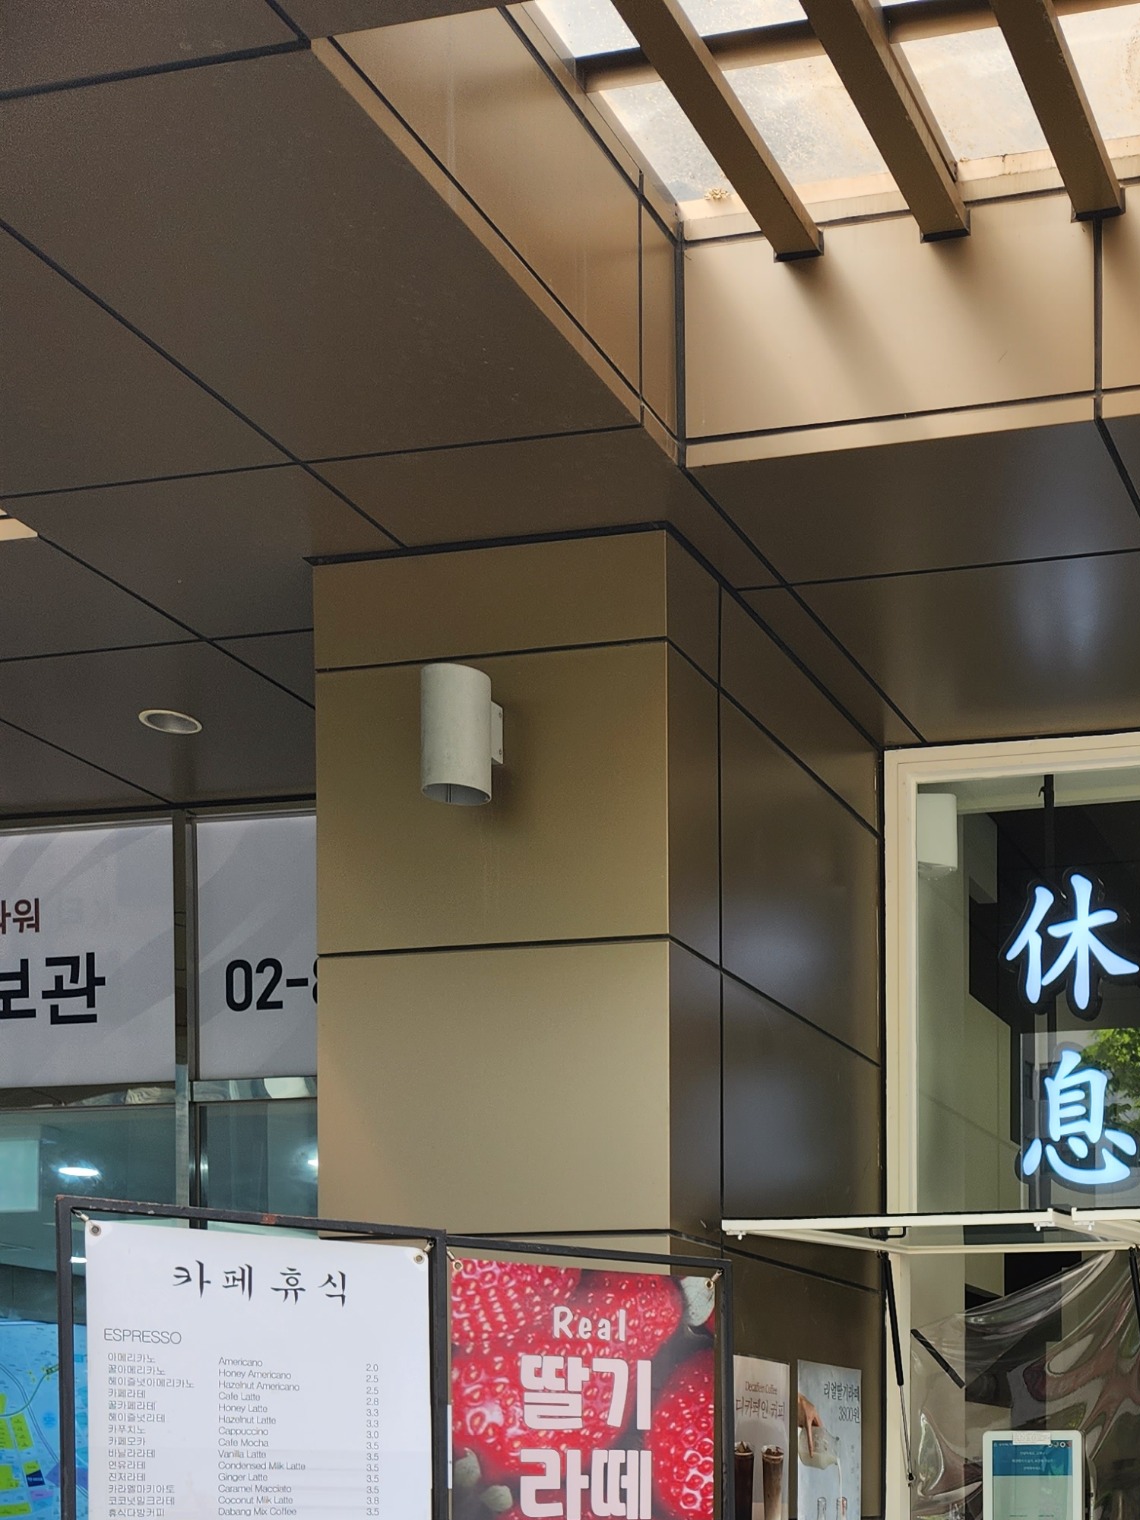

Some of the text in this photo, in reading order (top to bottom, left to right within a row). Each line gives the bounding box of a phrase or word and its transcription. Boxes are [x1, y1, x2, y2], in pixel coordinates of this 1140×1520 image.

[225, 958, 317, 1012] 02-
[554, 1306, 626, 1341] Real
[103, 1328, 182, 1345] ESPRESSO
[108, 1352, 156, 1363] 아메리카노
[219, 1357, 263, 1367] Americano
[366, 1364, 379, 1372] 2.0
[219, 1369, 291, 1379] Honey Americano
[366, 1375, 379, 1383] 2.5
[219, 1380, 300, 1391] Hazelnut Americano
[366, 1387, 379, 1395] 2.5
[519, 1355, 652, 1431] 딸기
[219, 1392, 260, 1401] Cafe Latte
[366, 1398, 379, 1406] 2.8
[219, 1404, 245, 1413] Honey
[366, 1409, 379, 1417] 3.3
[219, 1426, 268, 1435] Cappuccino
[366, 1431, 379, 1439] 3.0
[218, 1438, 269, 1447] Cafe Mocha
[366, 1442, 379, 1450] 3.5
[218, 1484, 252, 1493] Caramel
[519, 1449, 652, 1520] 라떼
[366, 1486, 379, 1494] 3.5
[218, 1507, 297, 1516] Dabang Mix Coffee
[366, 1508, 379, 1516] 3.5
